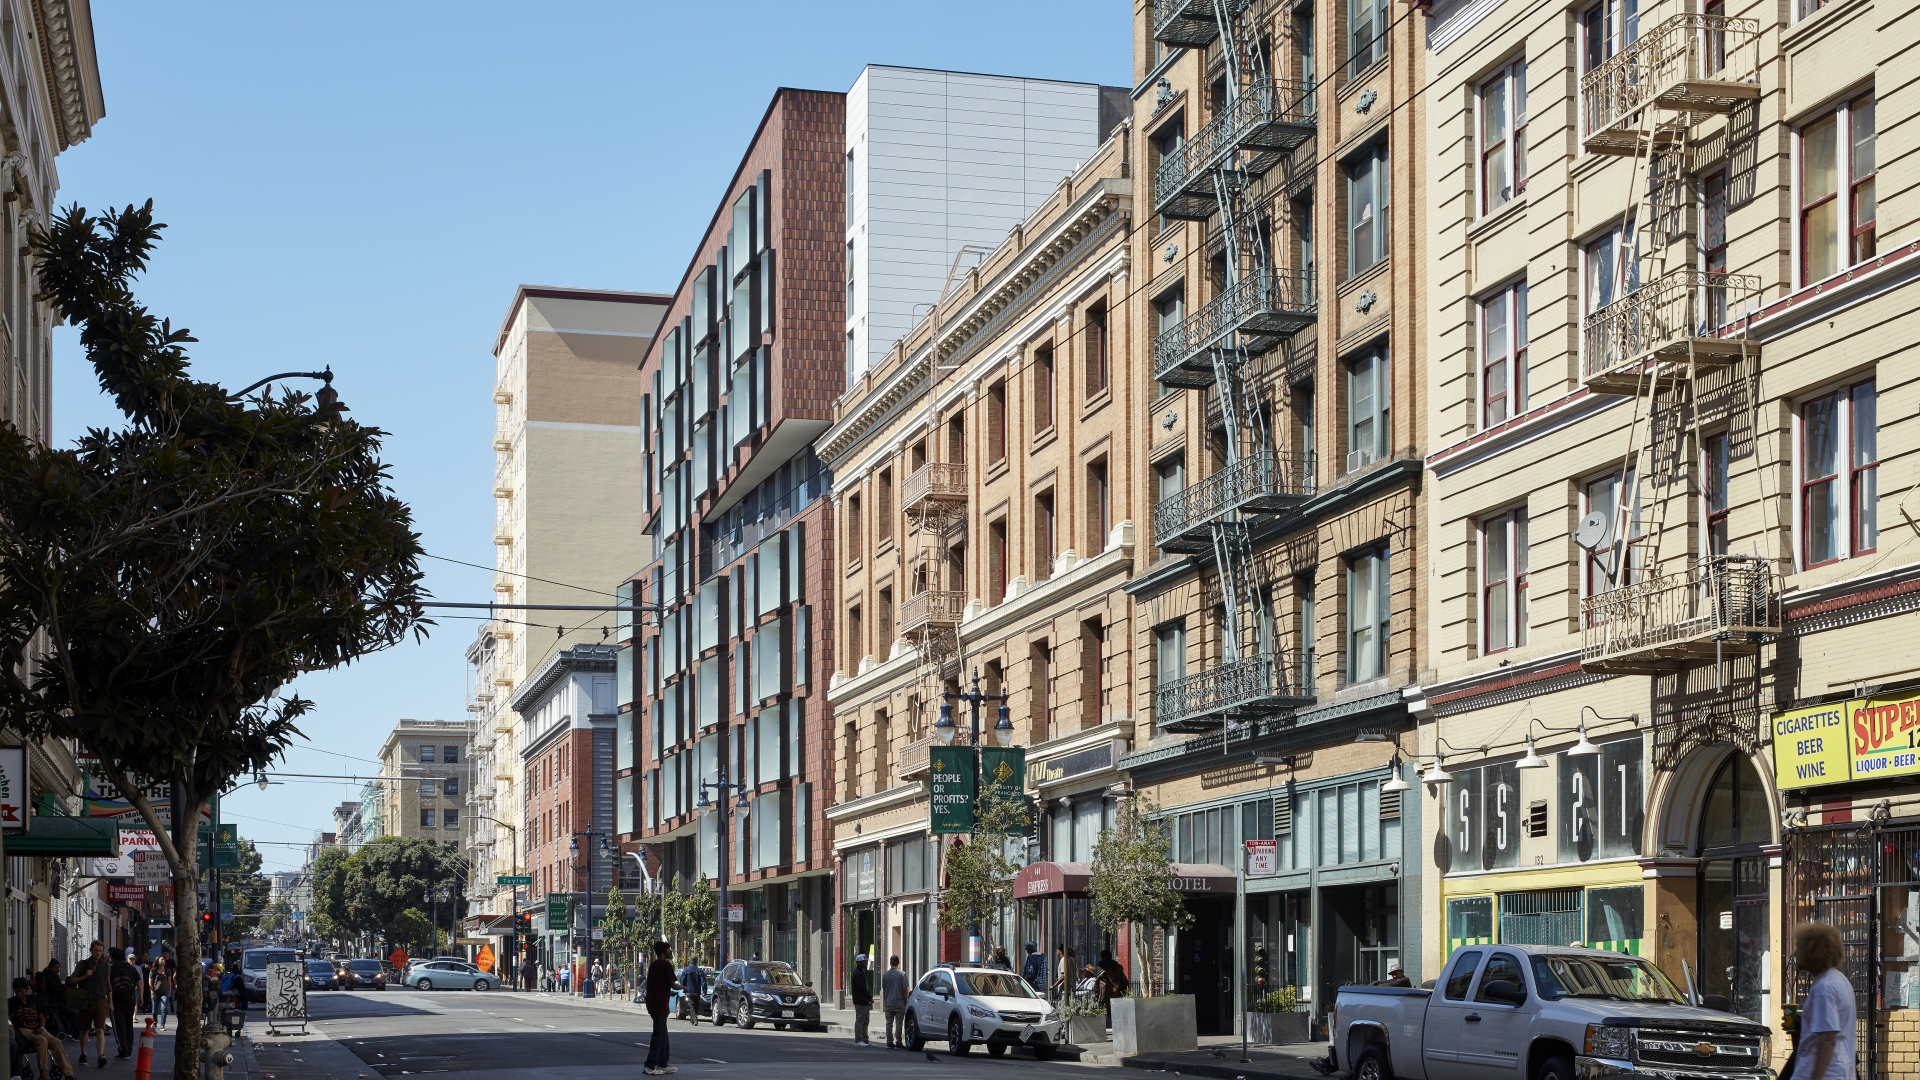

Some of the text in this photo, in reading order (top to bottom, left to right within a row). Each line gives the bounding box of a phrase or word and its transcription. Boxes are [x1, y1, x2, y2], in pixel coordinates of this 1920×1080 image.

[1776, 710, 1841, 736] CIGARETTES
[1797, 738, 1824, 756] BEER
[1856, 753, 1916, 774] LIQUOR BEER
[1046, 767, 1064, 782] Theatre
[1796, 761, 1826, 780] WINE
[933, 774, 961, 783] PEOPLE
[97, 785, 171, 798] THTRE
[933, 785, 945, 793] OR
[933, 795, 969, 804] PROFITS?
[933, 805, 951, 814] YES.
[1256, 847, 1275, 855] PARKING
[135, 852, 145, 862] NO
[502, 877, 528, 885] Taylor
[1028, 879, 1049, 893] EMPRESS
[110, 885, 145, 893] Restaurant
